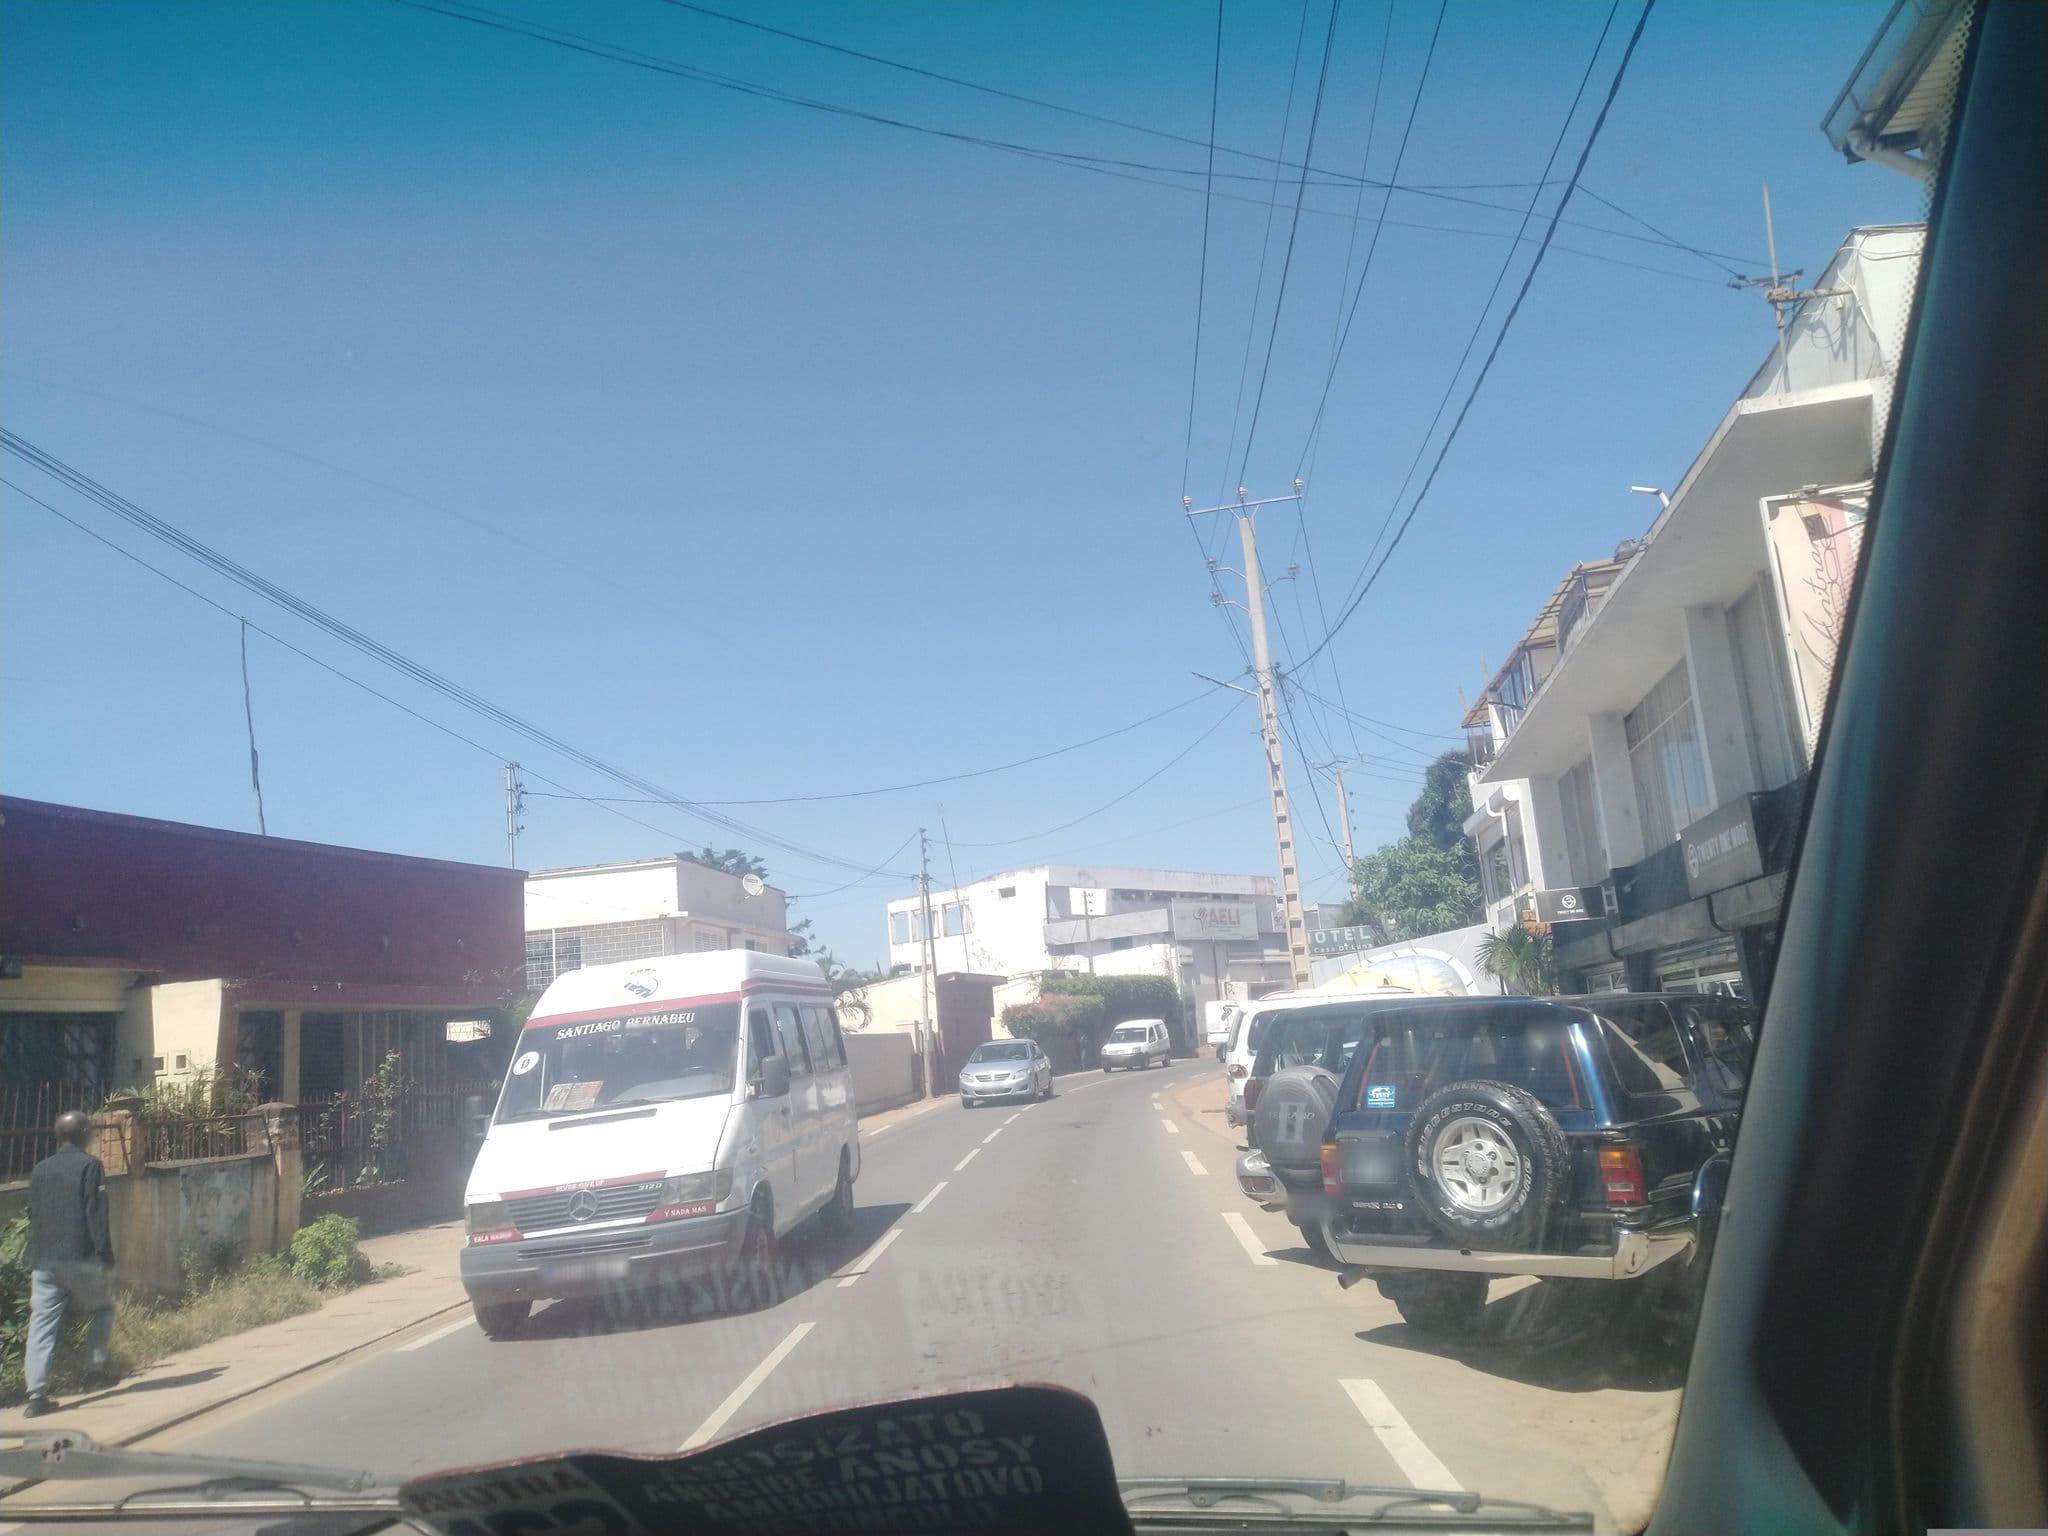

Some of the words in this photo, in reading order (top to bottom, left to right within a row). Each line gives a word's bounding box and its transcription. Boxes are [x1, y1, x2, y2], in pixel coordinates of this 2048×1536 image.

[556, 1019, 621, 1040] SANTIAGO
[626, 1012, 696, 1029] BERNABEU
[839, 1434, 1035, 1482] ANOSY
